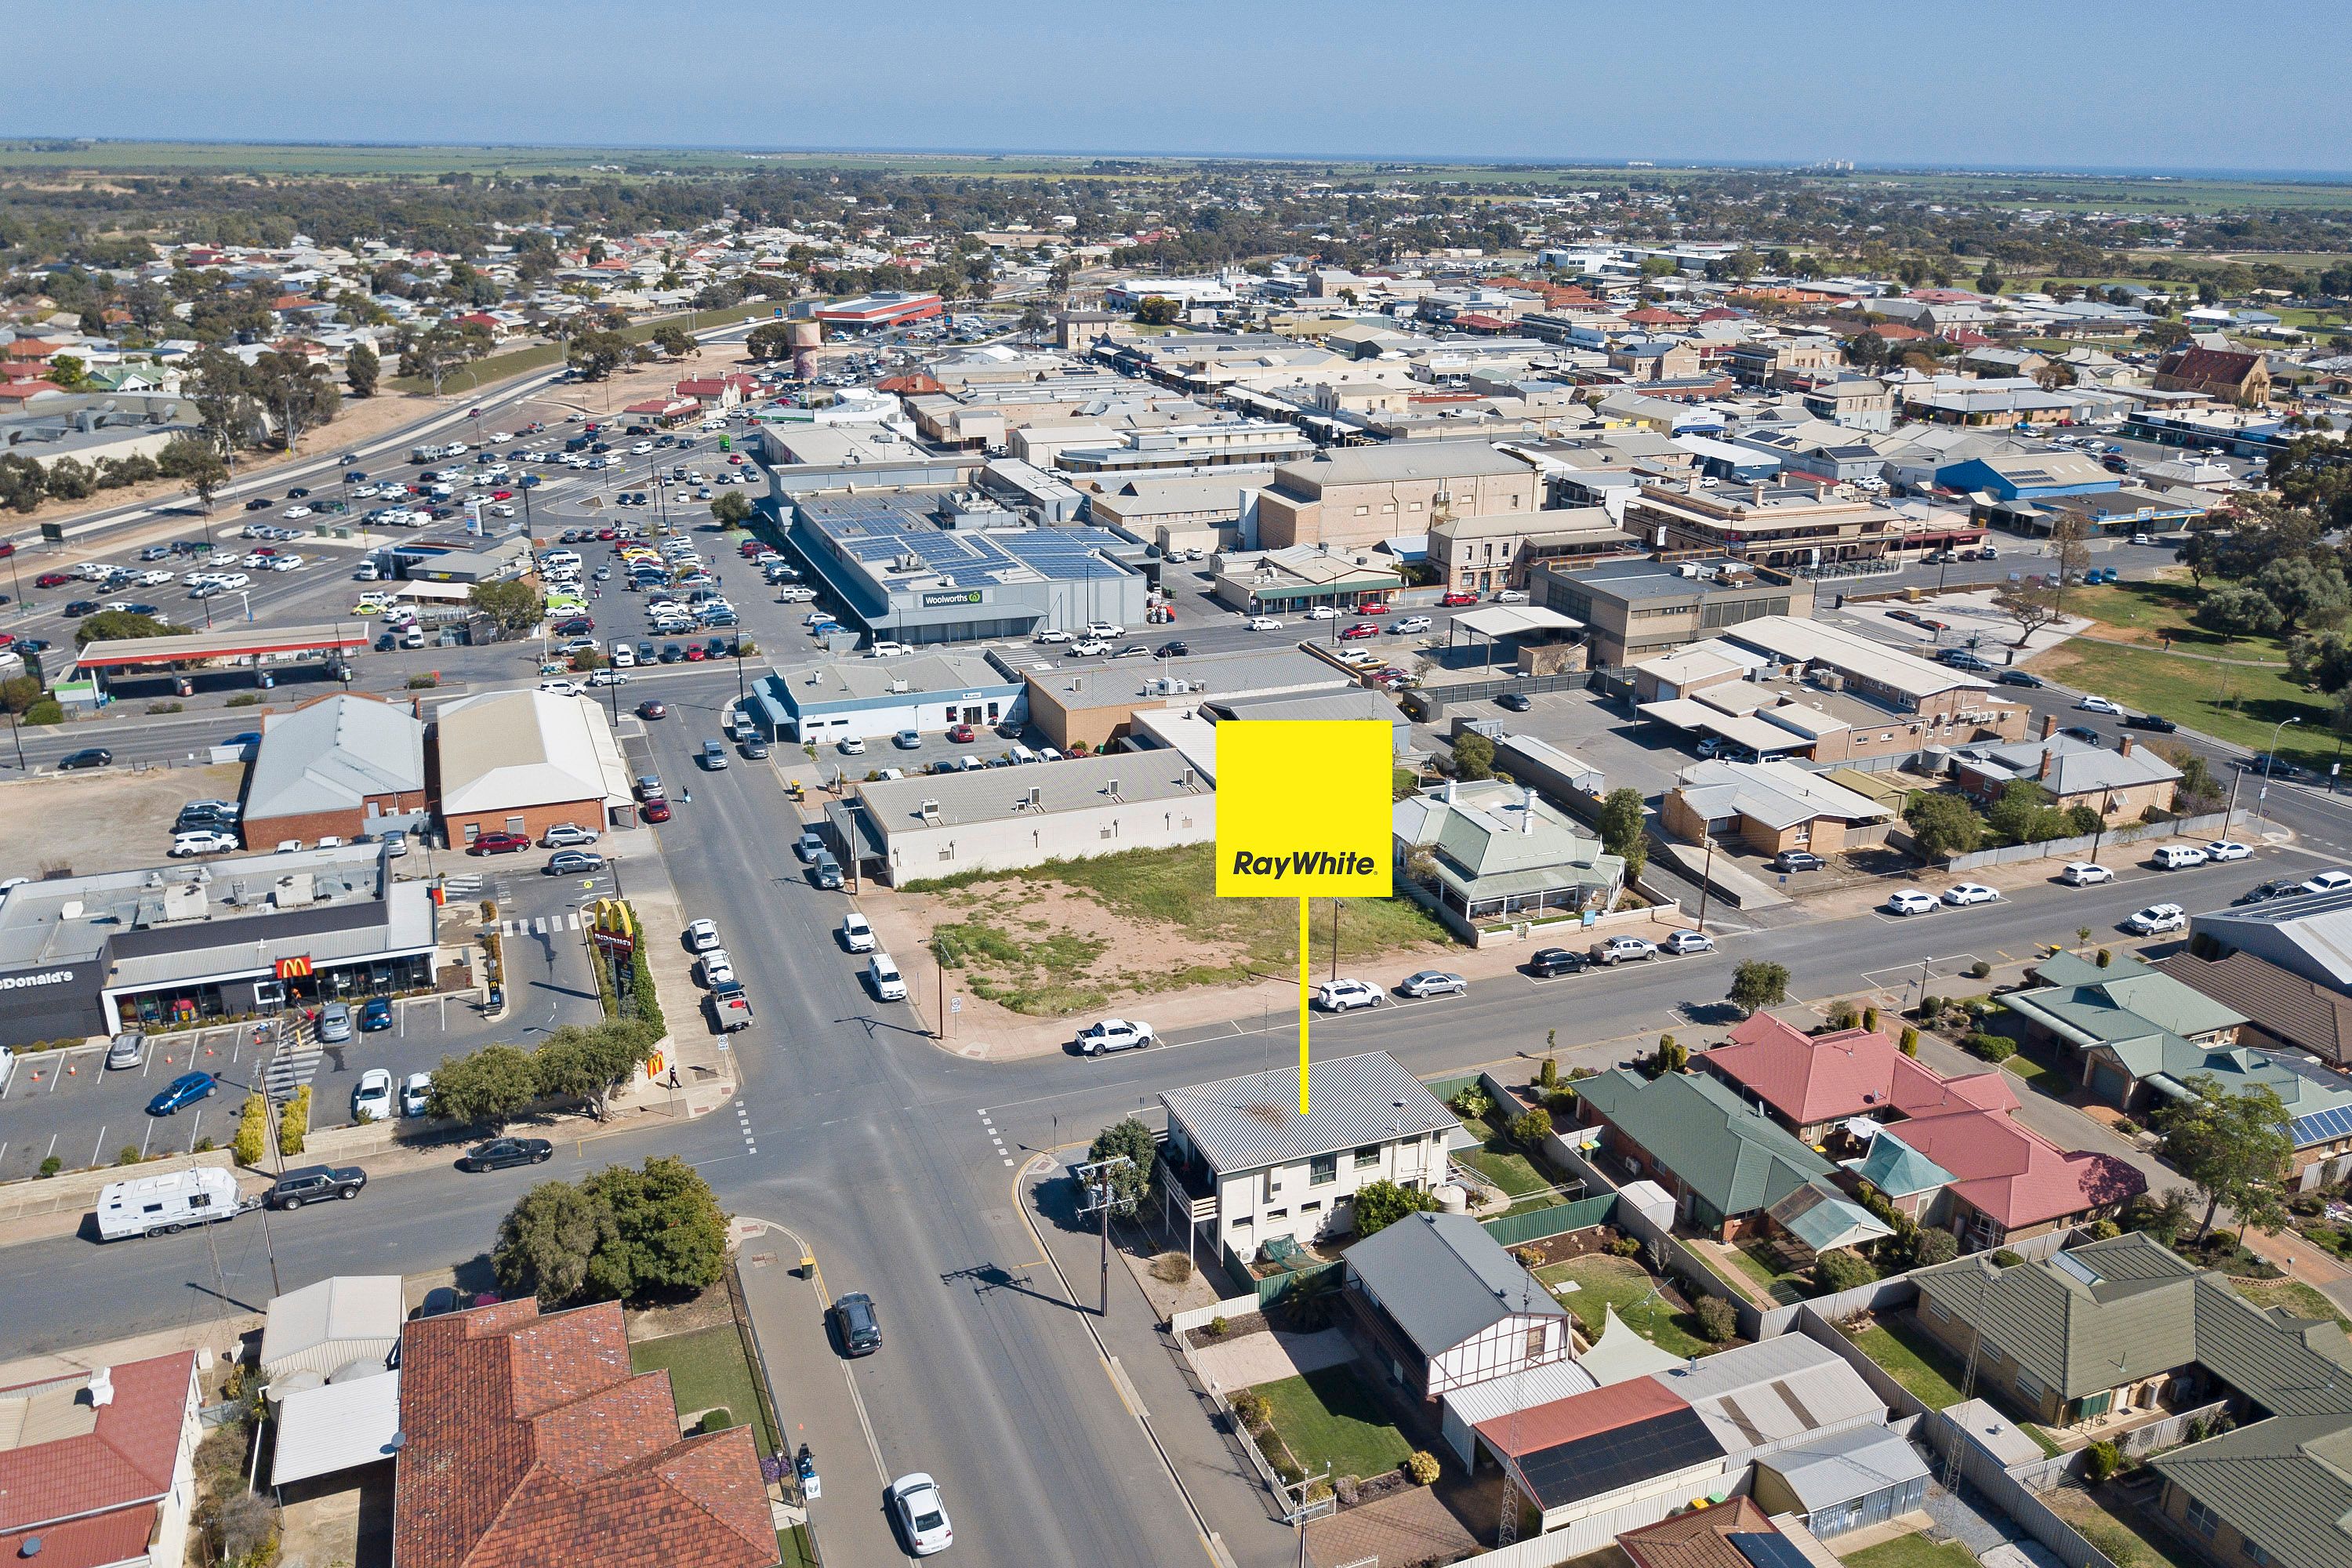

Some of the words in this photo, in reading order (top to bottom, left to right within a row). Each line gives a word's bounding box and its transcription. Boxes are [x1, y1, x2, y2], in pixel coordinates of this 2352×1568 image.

[925, 593, 968, 604] Woolworths
[594, 933, 631, 946] McDonald's
[0, 971, 73, 990] Donald's
